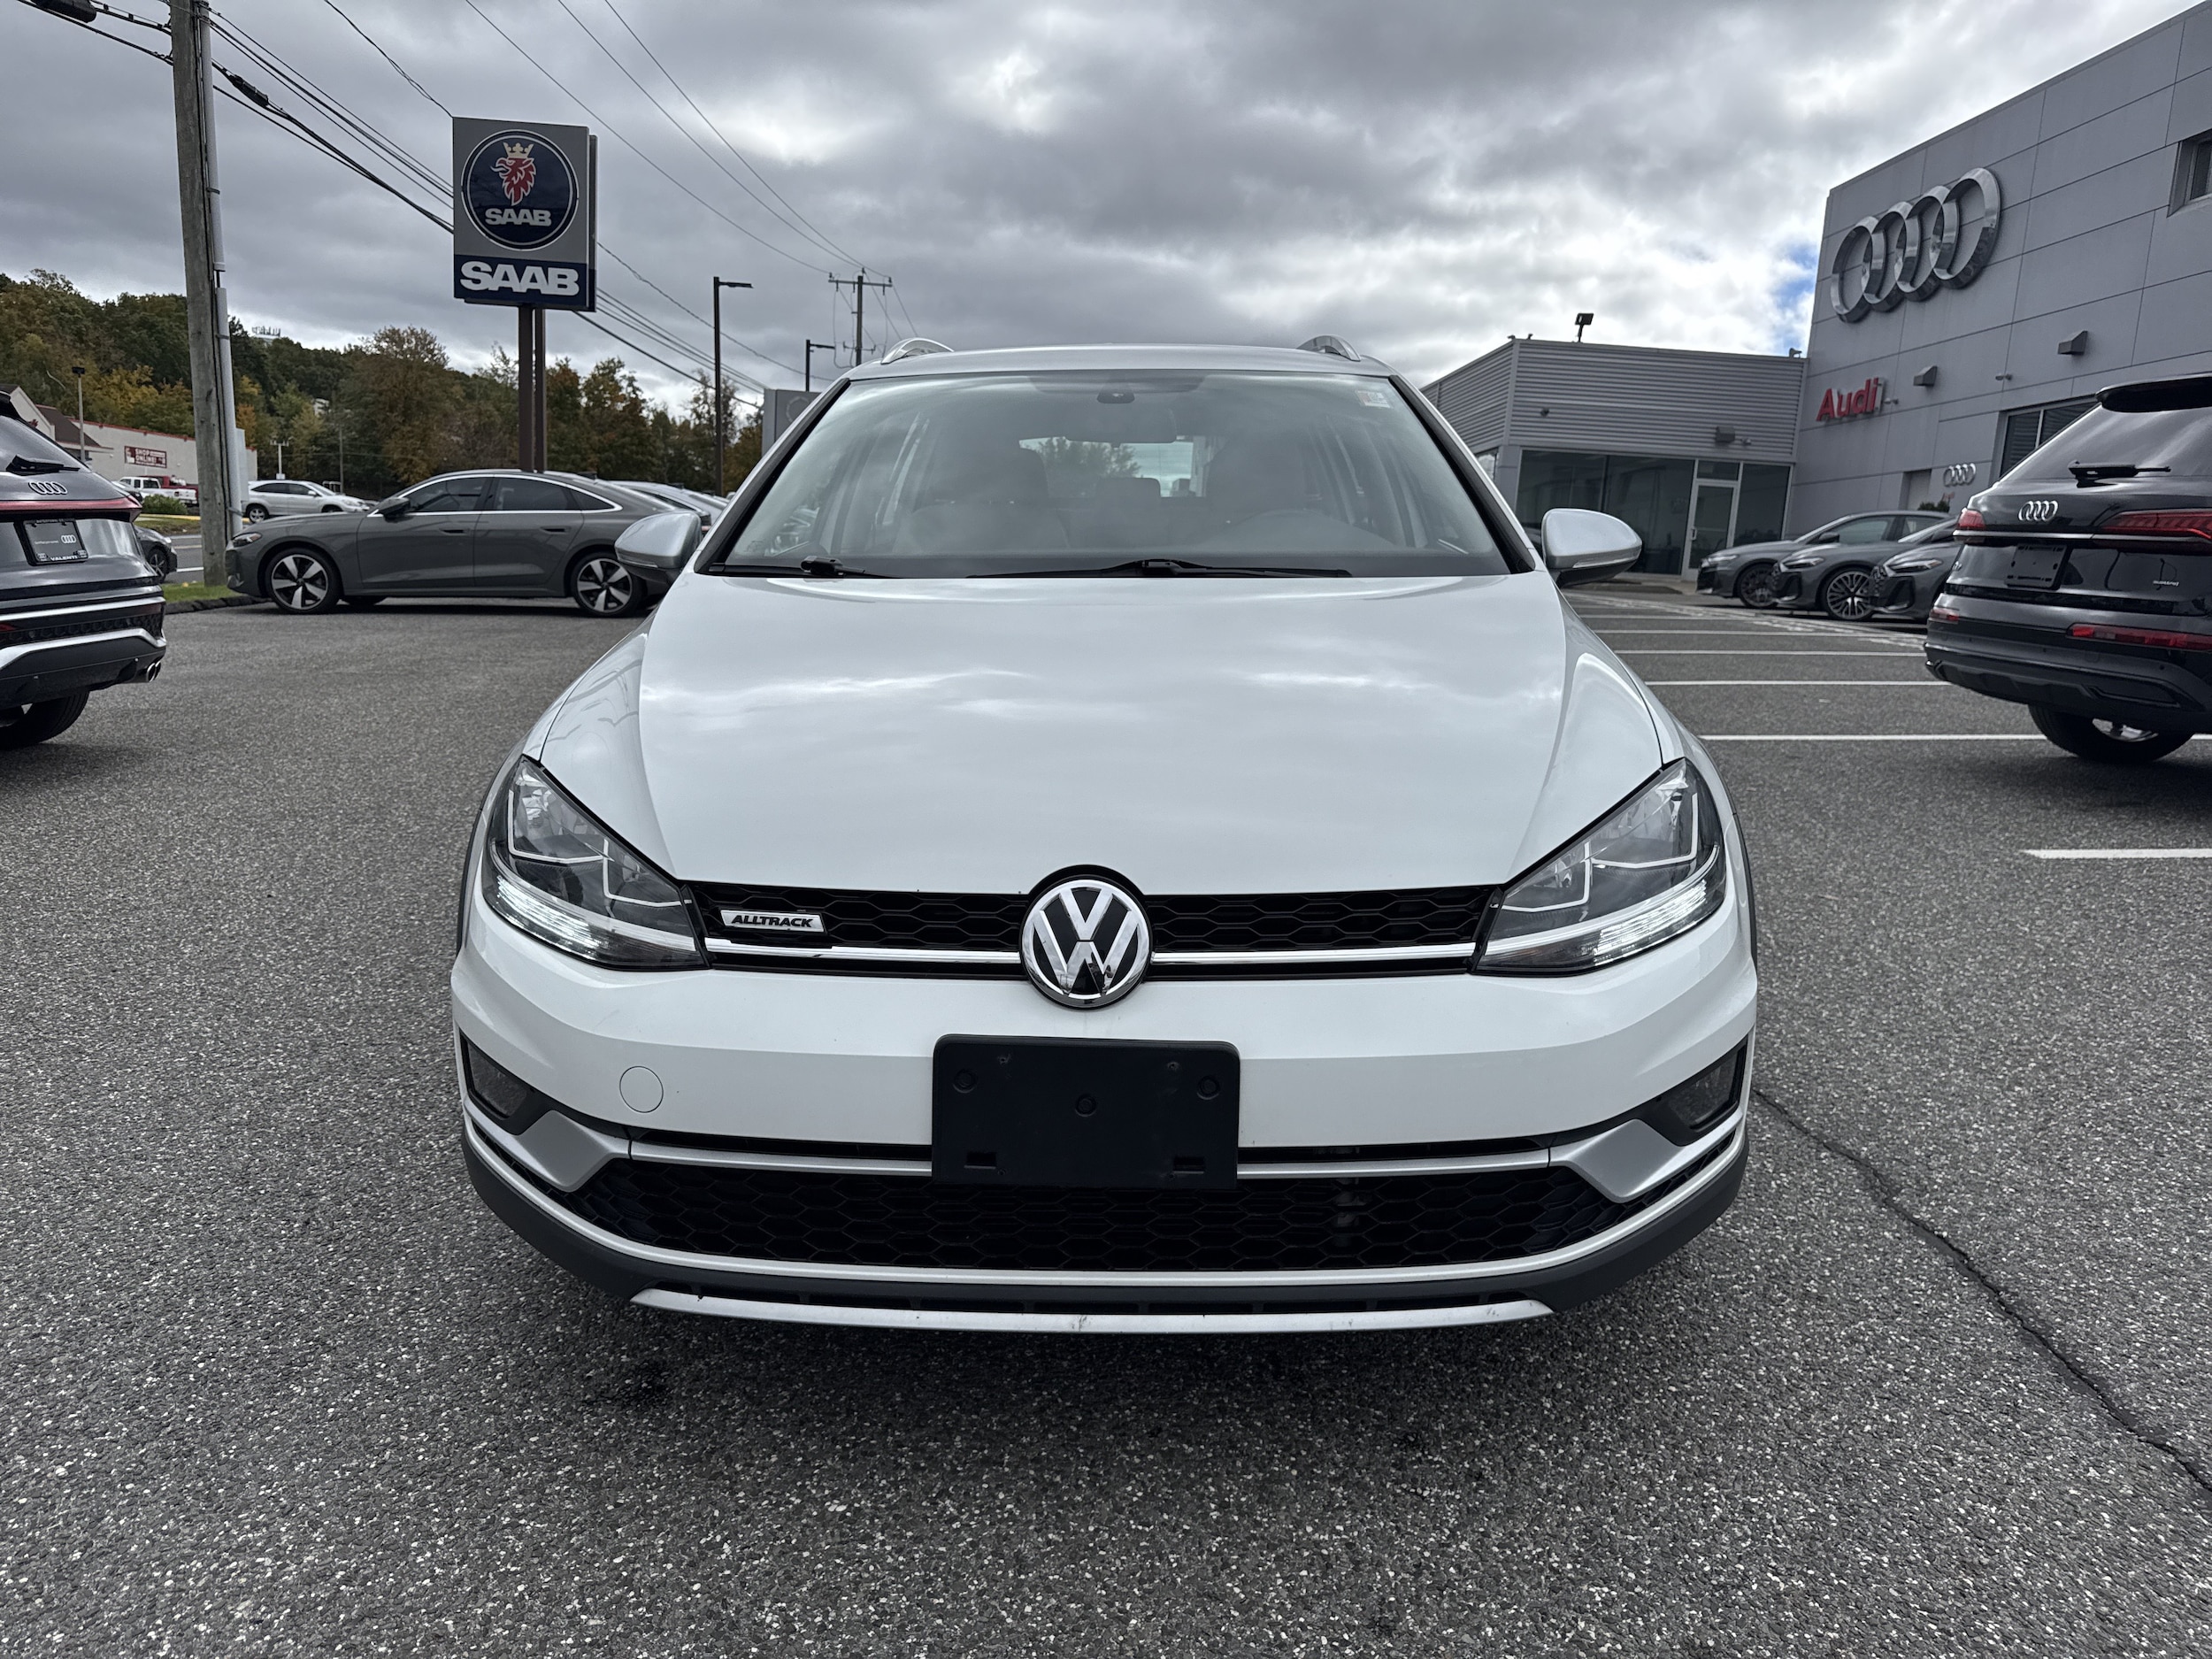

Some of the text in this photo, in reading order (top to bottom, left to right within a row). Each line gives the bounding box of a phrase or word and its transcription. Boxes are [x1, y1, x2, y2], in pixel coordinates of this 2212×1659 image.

[485, 208, 552, 227] SAAB
[459, 260, 580, 296] SAAB
[1816, 378, 1880, 421] Audi
[731, 914, 814, 928] ALLTRACK
